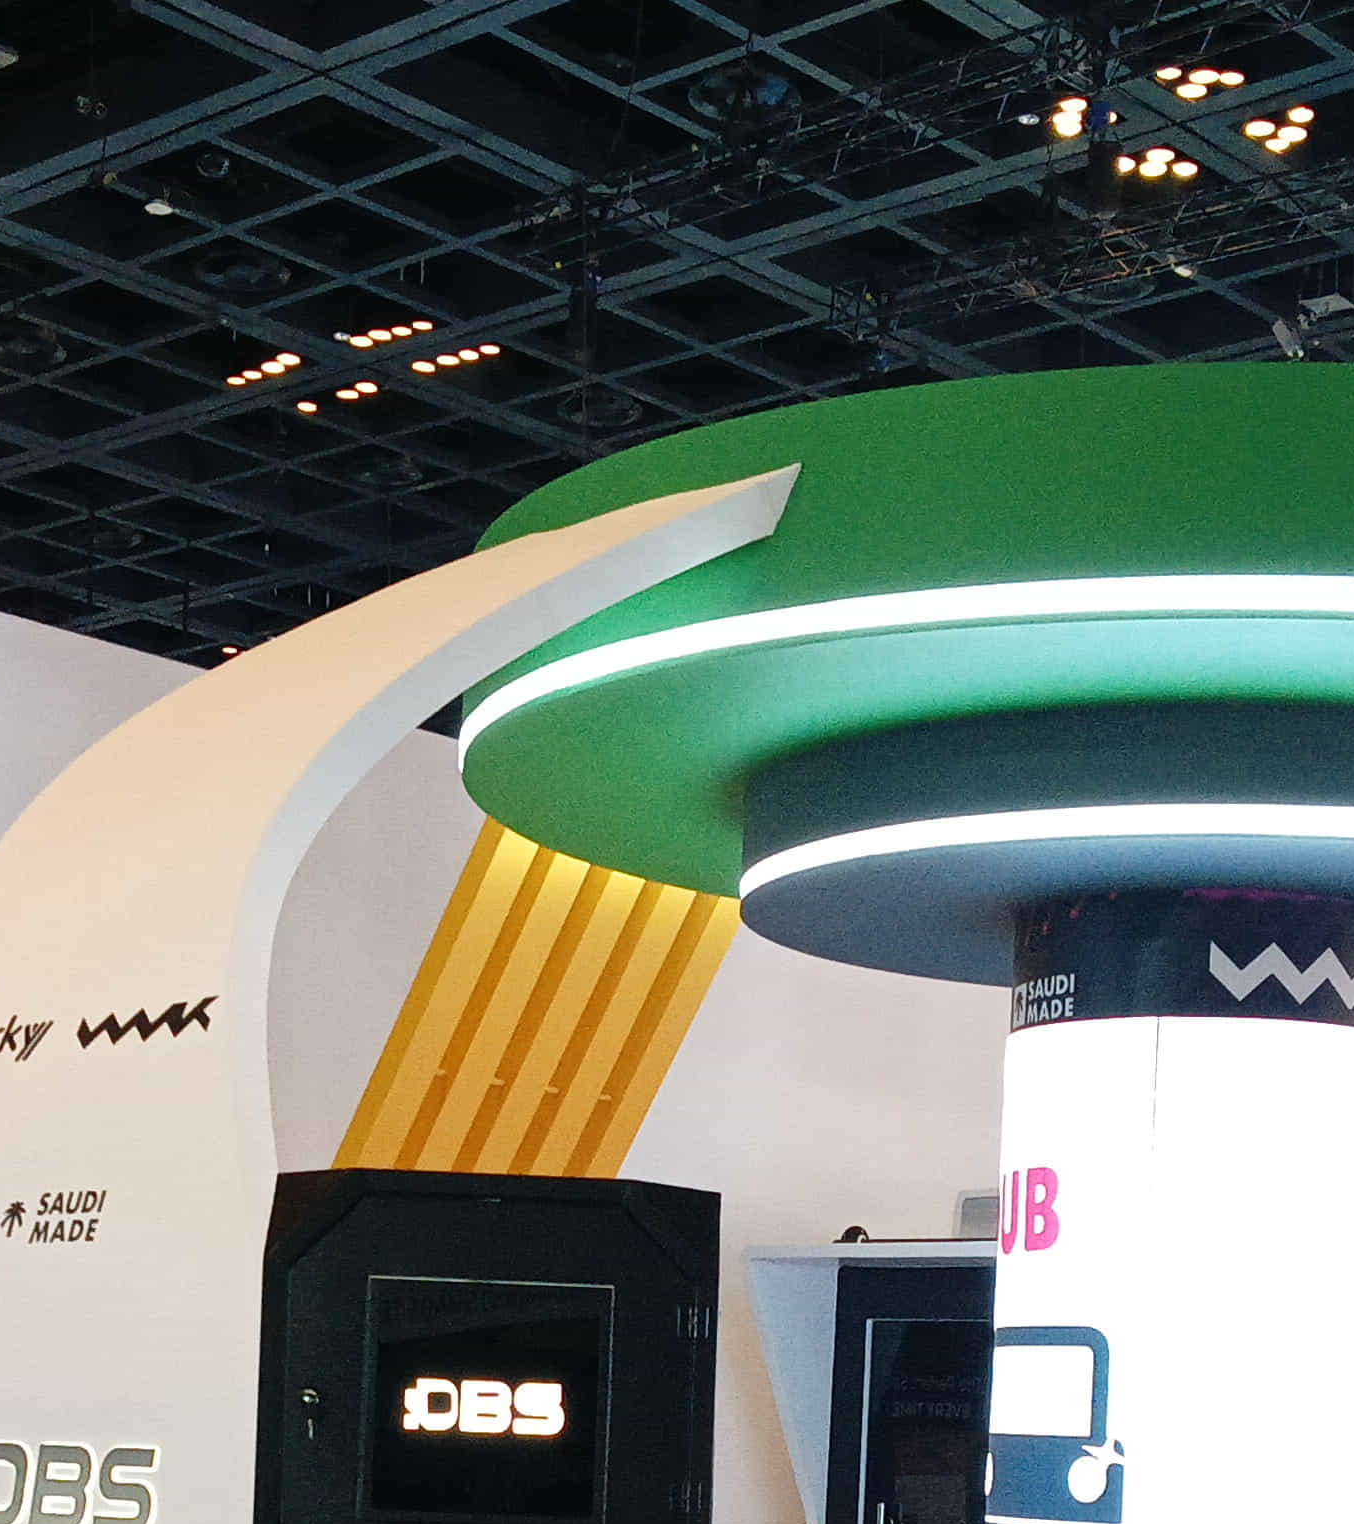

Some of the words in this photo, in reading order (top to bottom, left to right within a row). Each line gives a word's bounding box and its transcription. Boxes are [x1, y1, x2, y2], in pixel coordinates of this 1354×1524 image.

[1028, 973, 1076, 997] SAUDI
[1027, 998, 1075, 1022] MADE
[36, 1190, 107, 1216] SAUDI
[1001, 1166, 1060, 1254] UB
[28, 1218, 99, 1244] MADE
[402, 1376, 566, 1438] DBS
